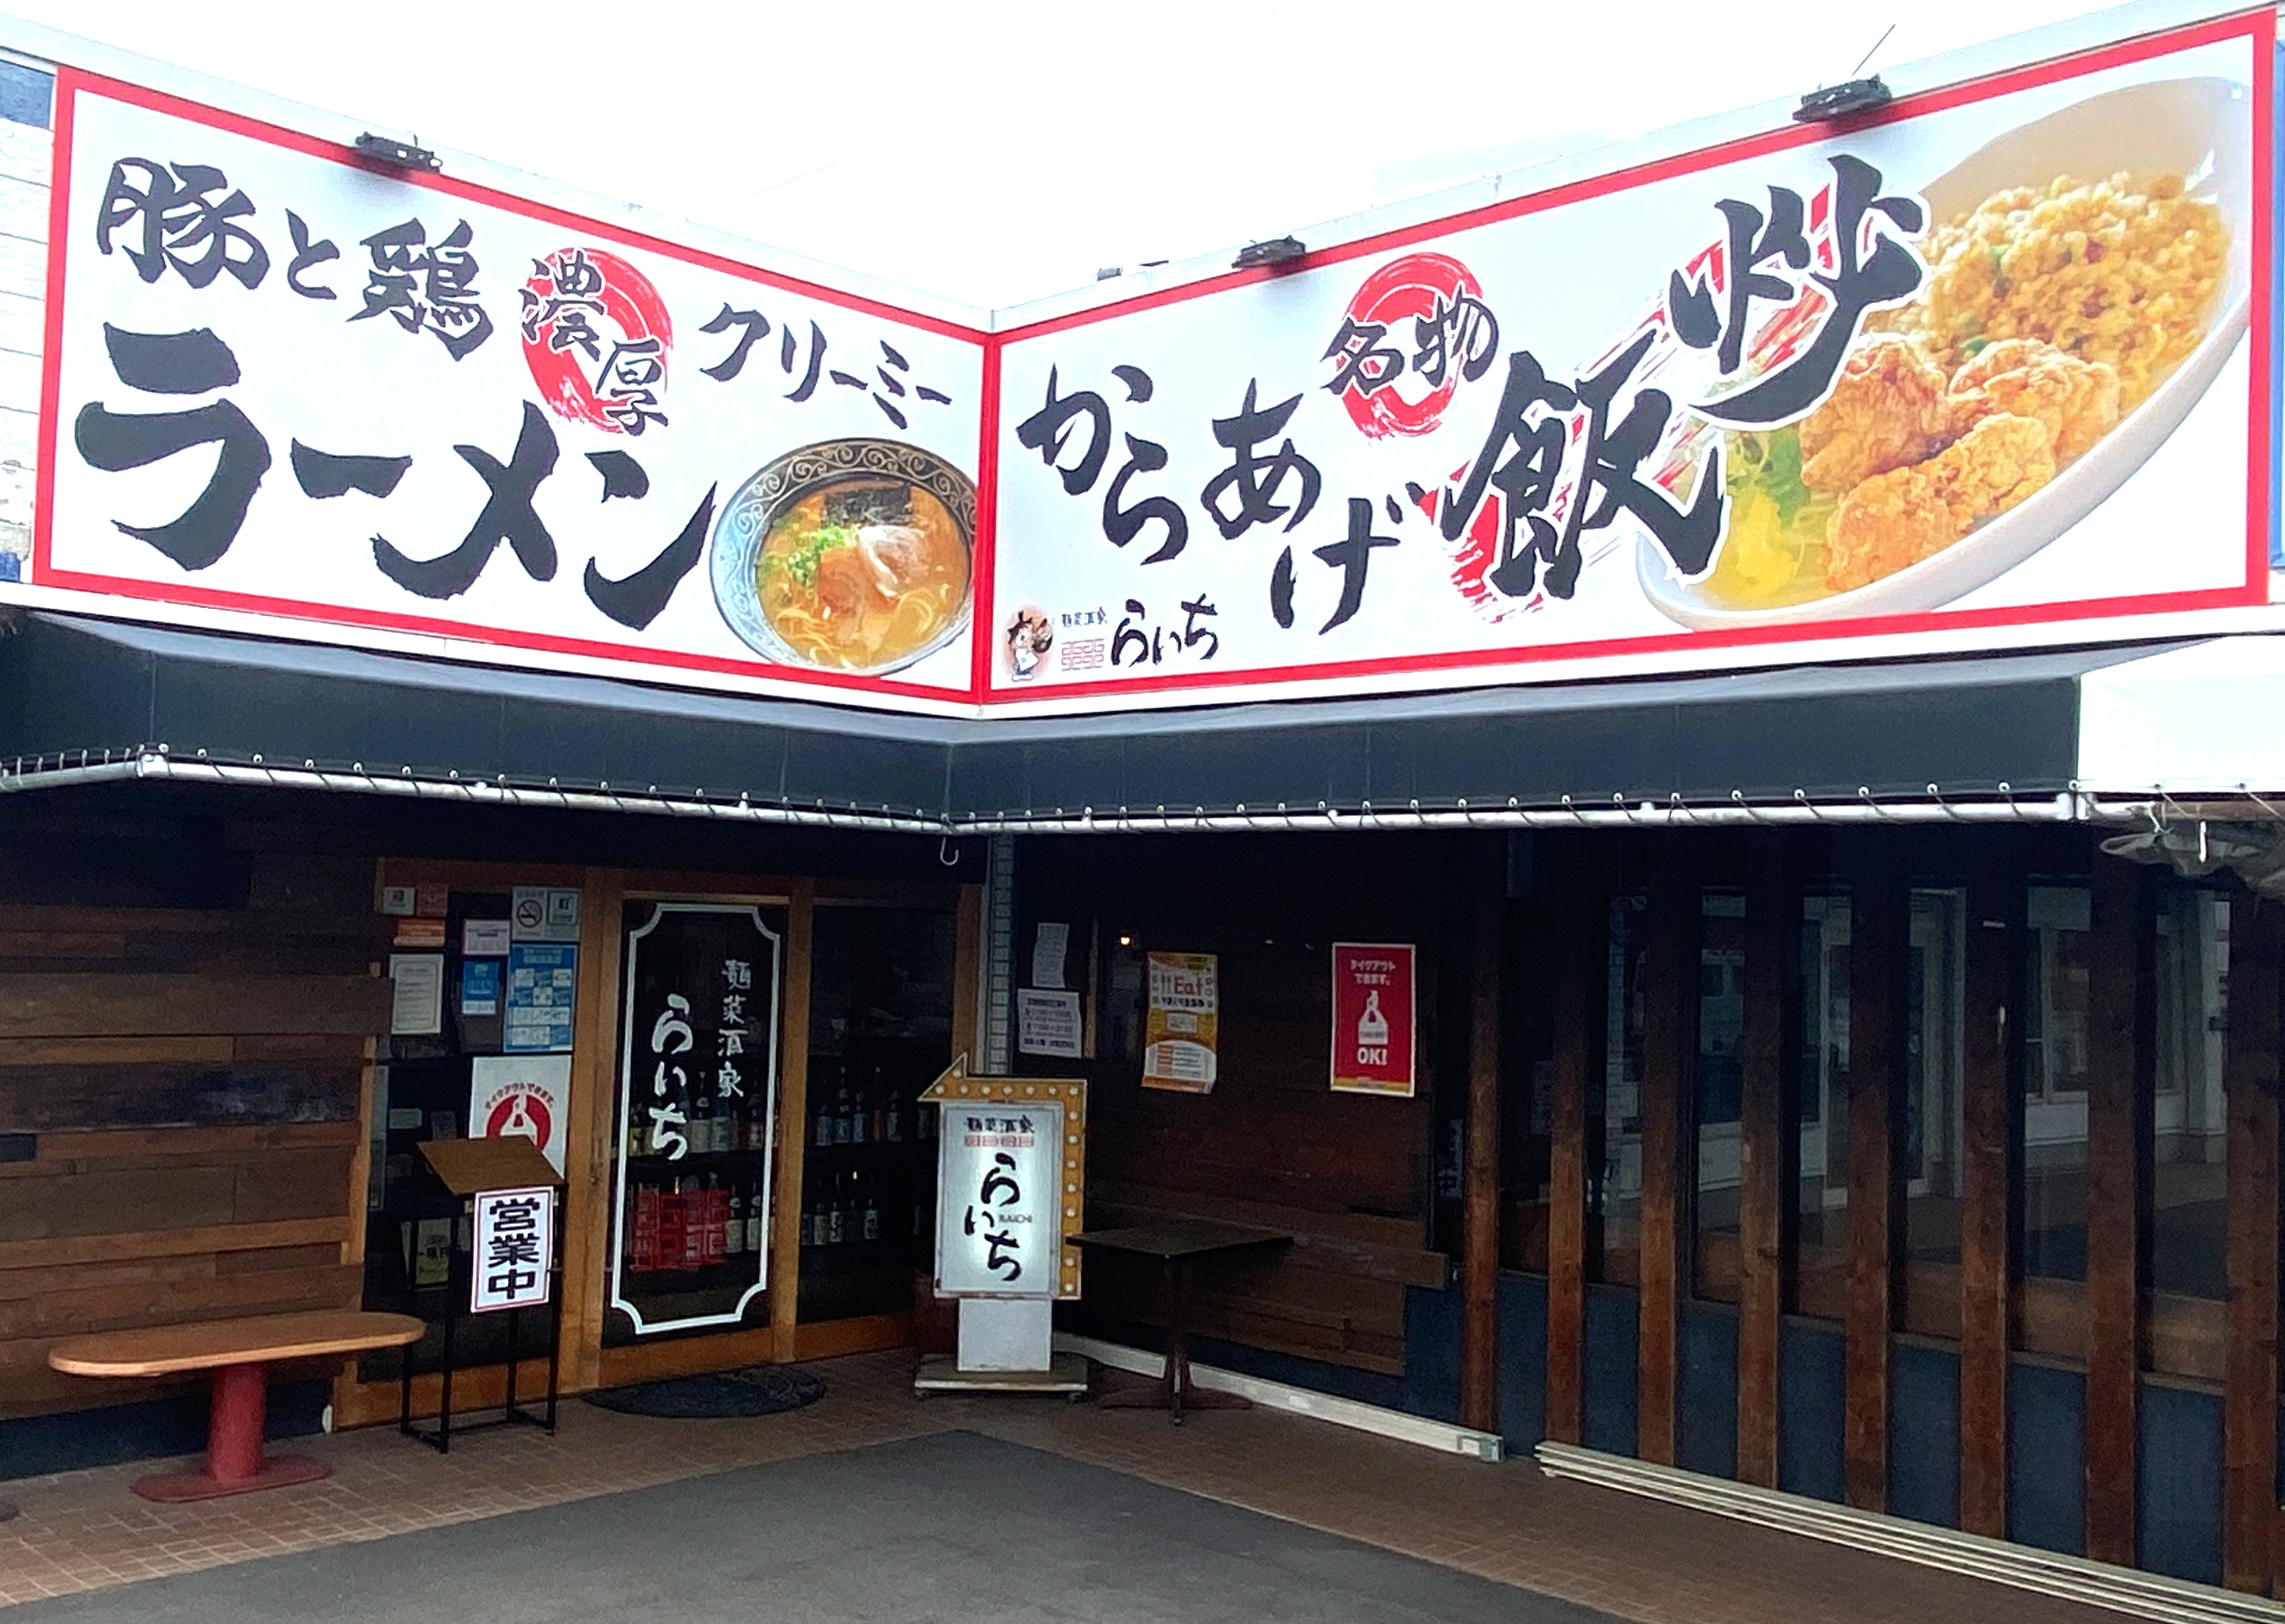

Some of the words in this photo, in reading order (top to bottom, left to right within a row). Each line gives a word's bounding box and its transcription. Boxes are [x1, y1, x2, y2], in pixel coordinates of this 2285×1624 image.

[97, 157, 493, 361] 豚と鶏
[519, 250, 669, 437] 濃厚
[698, 302, 953, 430] クリーミー
[1321, 283, 1499, 396] 名物
[74, 321, 719, 632] ラーメン
[1016, 362, 1428, 635] からあげ
[1111, 593, 1219, 668] らいち
[648, 994, 694, 1161] らいち
[488, 1197, 541, 1300] 営業中
[964, 1152, 1021, 1282] らいち
